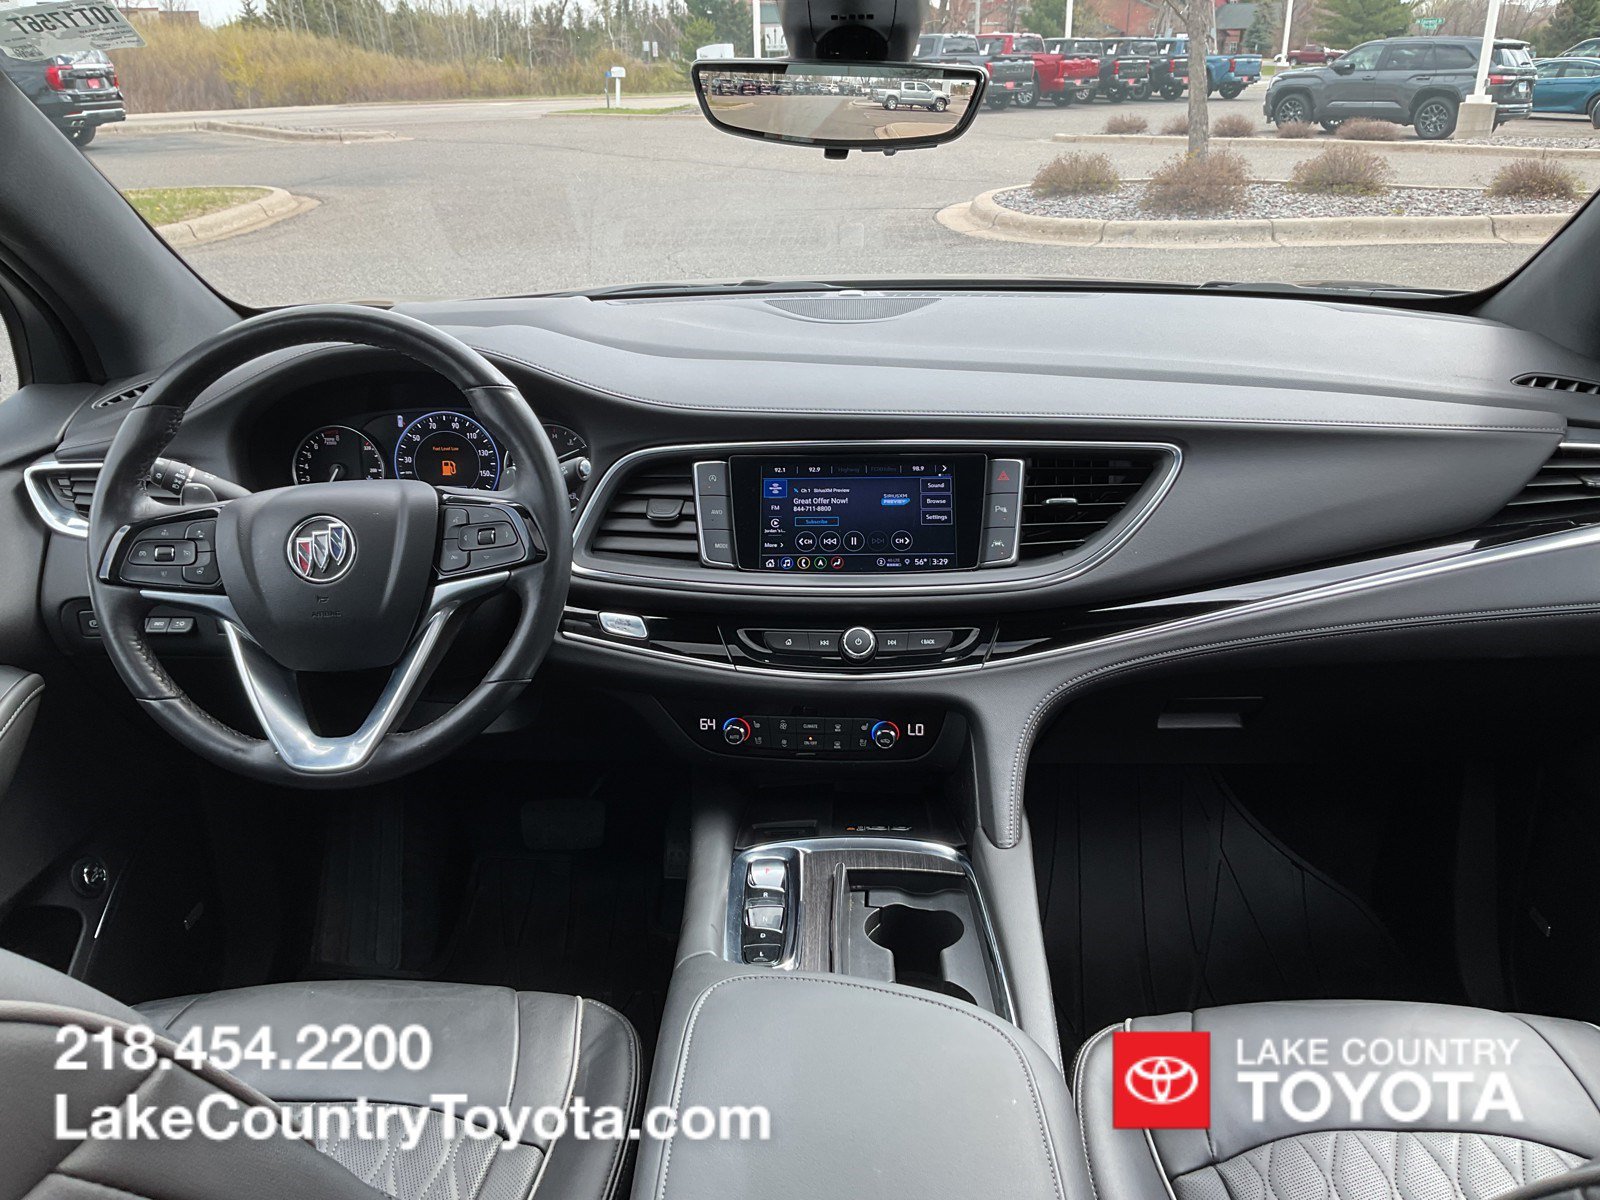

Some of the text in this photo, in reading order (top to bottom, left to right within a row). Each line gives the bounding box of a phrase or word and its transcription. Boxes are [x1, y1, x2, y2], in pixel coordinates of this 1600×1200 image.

[429, 422, 437, 430] 70
[451, 422, 460, 430] 90
[412, 434, 421, 442] 50
[466, 432, 478, 440] 110
[478, 449, 489, 457] 130
[404, 456, 413, 464] 30
[480, 470, 490, 478] 150
[793, 497, 849, 505] Great Offer Now!
[925, 513, 948, 521] Settings
[931, 557, 949, 566] 3:29
[699, 718, 716, 731] 64
